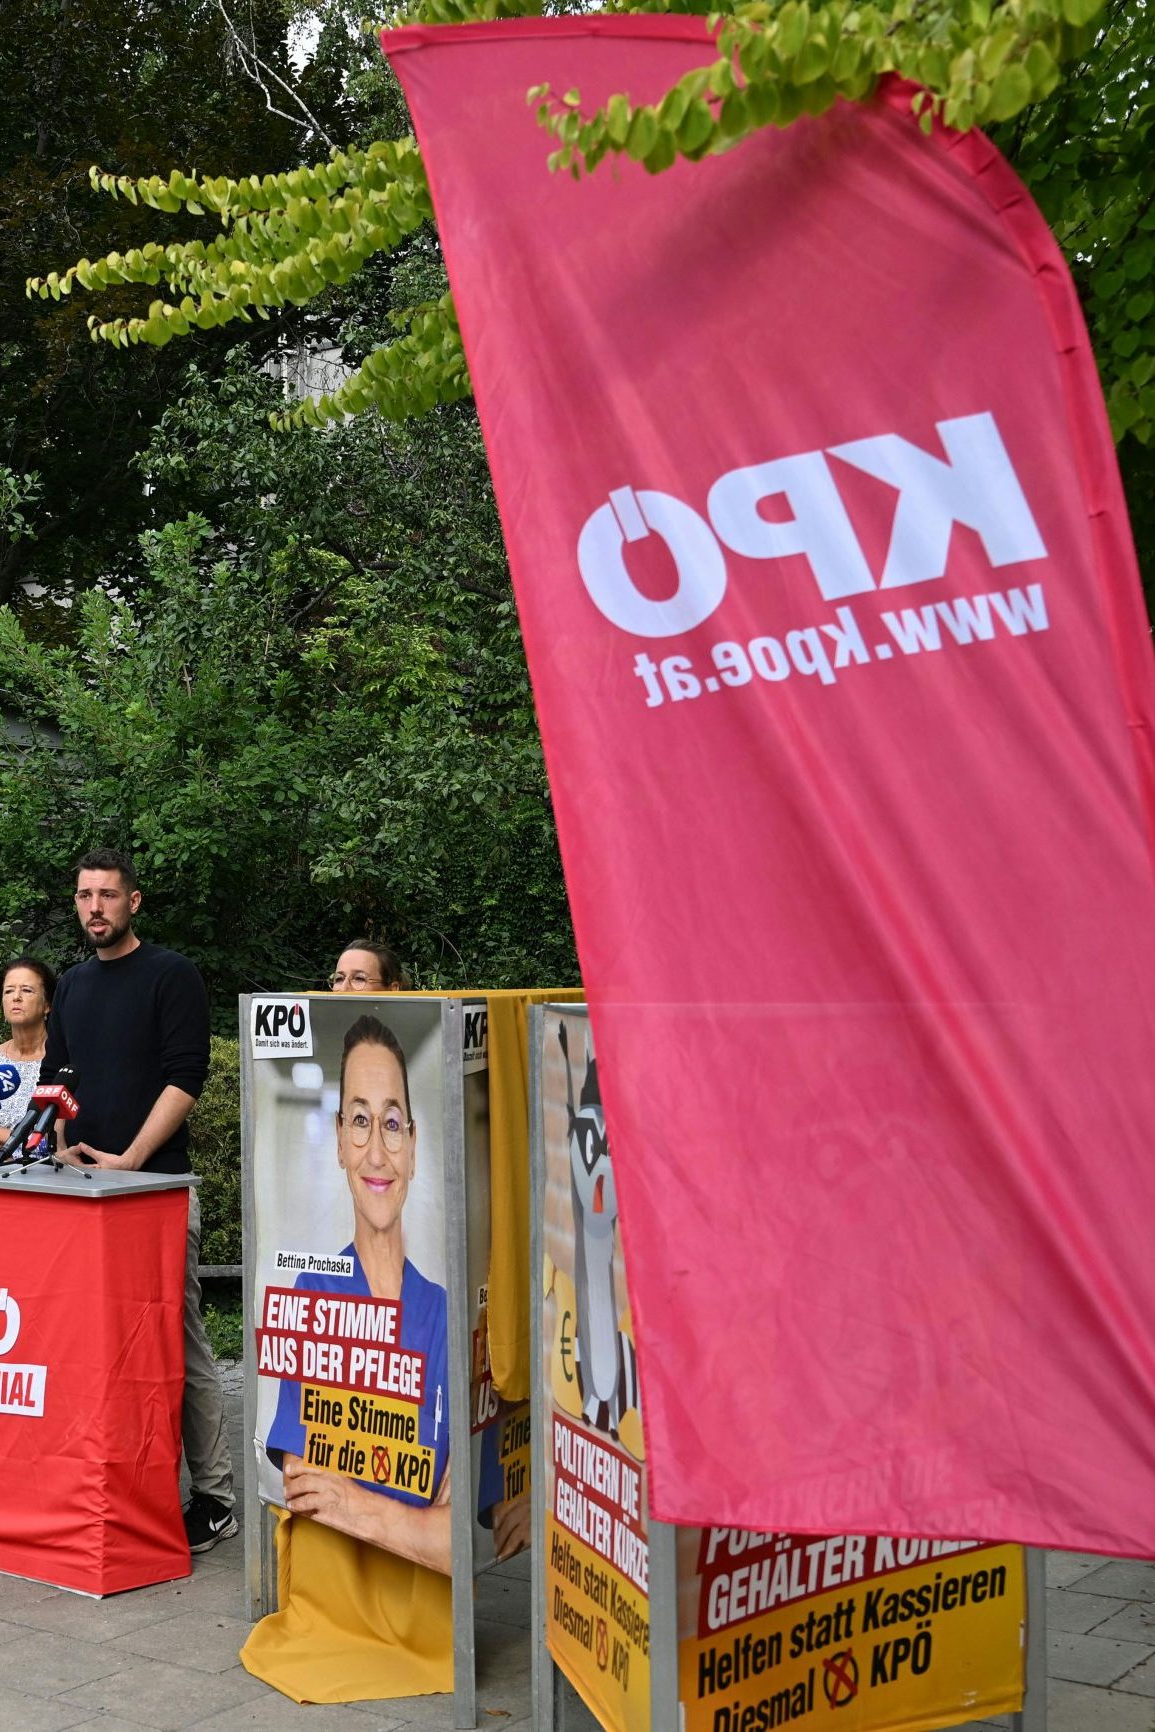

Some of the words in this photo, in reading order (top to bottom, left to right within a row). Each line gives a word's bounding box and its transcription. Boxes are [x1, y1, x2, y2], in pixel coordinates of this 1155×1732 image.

[256, 1039, 268, 1047] Damit
[270, 1039, 280, 1047] sich
[463, 1012, 488, 1049] KP
[36, 1087, 61, 1096] ORF
[61, 1091, 79, 1113] ORF
[277, 1253, 306, 1269] Bettina
[308, 1255, 351, 1274] Prochaska
[266, 1293, 310, 1332] EINE
[313, 1298, 397, 1344] STIMME
[259, 1334, 297, 1375] AUS
[302, 1340, 344, 1382] DER
[349, 1346, 422, 1398] PFLEGE
[303, 1388, 343, 1427] Eine
[347, 1396, 415, 1444] Stimme
[308, 1433, 334, 1467] für
[337, 1440, 366, 1476] die
[394, 1449, 431, 1494] KPÖ
[507, 1459, 526, 1501] für
[554, 1420, 620, 1505] POLITIKERN
[620, 1463, 639, 1521] DIE
[557, 1477, 612, 1561] GEHÄLTER
[613, 1513, 649, 1594] KÜRZE
[551, 1530, 581, 1589] Helfen
[583, 1561, 608, 1612] statt
[610, 1577, 650, 1657] Kassiere
[707, 1535, 867, 1630] GEHÄLTER
[553, 1584, 594, 1652] Diesmal
[611, 1636, 630, 1693] KPÖ
[698, 1630, 782, 1699] Helfen
[790, 1599, 855, 1661] statt
[862, 1565, 1006, 1634] Kassieren
[713, 1668, 815, 1732] Diesmal
[870, 1620, 932, 1688] KPÖ
